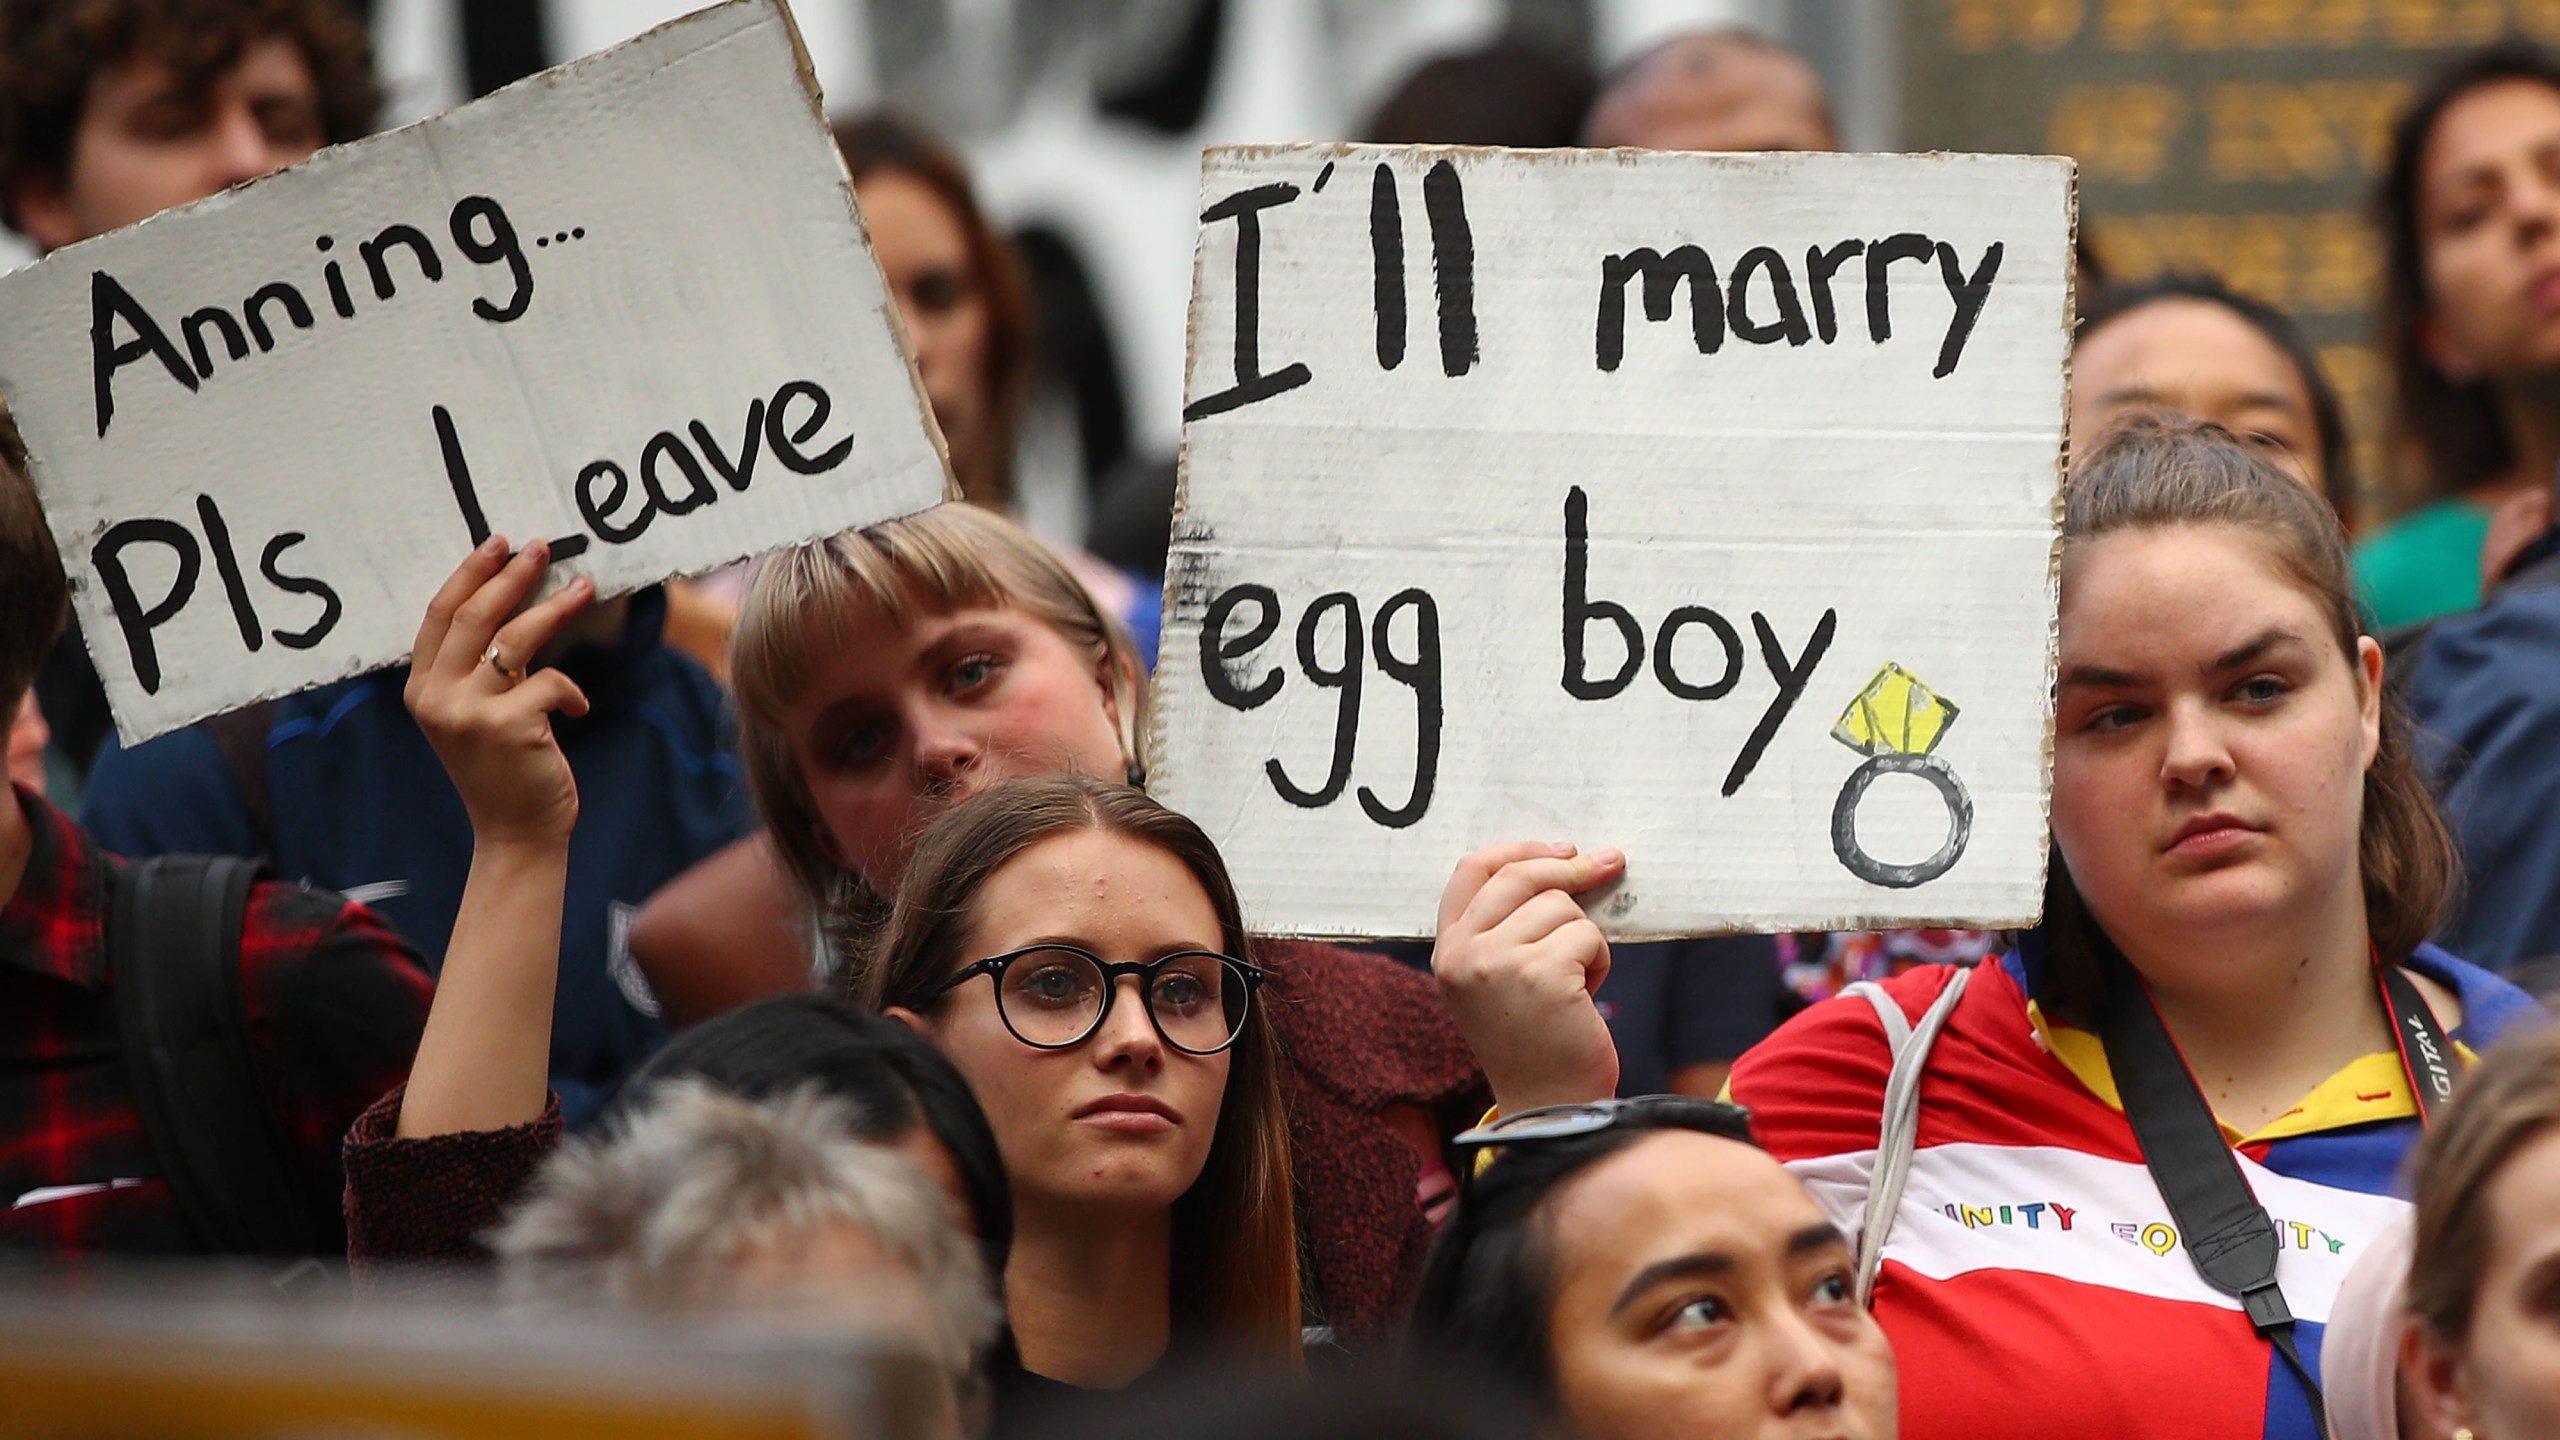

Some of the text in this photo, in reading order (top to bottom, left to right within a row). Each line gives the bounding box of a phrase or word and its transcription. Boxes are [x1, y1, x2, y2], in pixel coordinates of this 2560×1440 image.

[89, 195, 586, 440] Anning...
[1181, 159, 1480, 423] I'll
[1596, 233, 2004, 379] marry
[91, 380, 855, 697] Pls Leave
[1198, 485, 1838, 829] egg boy
[2110, 1218, 2346, 1257] EQITY
